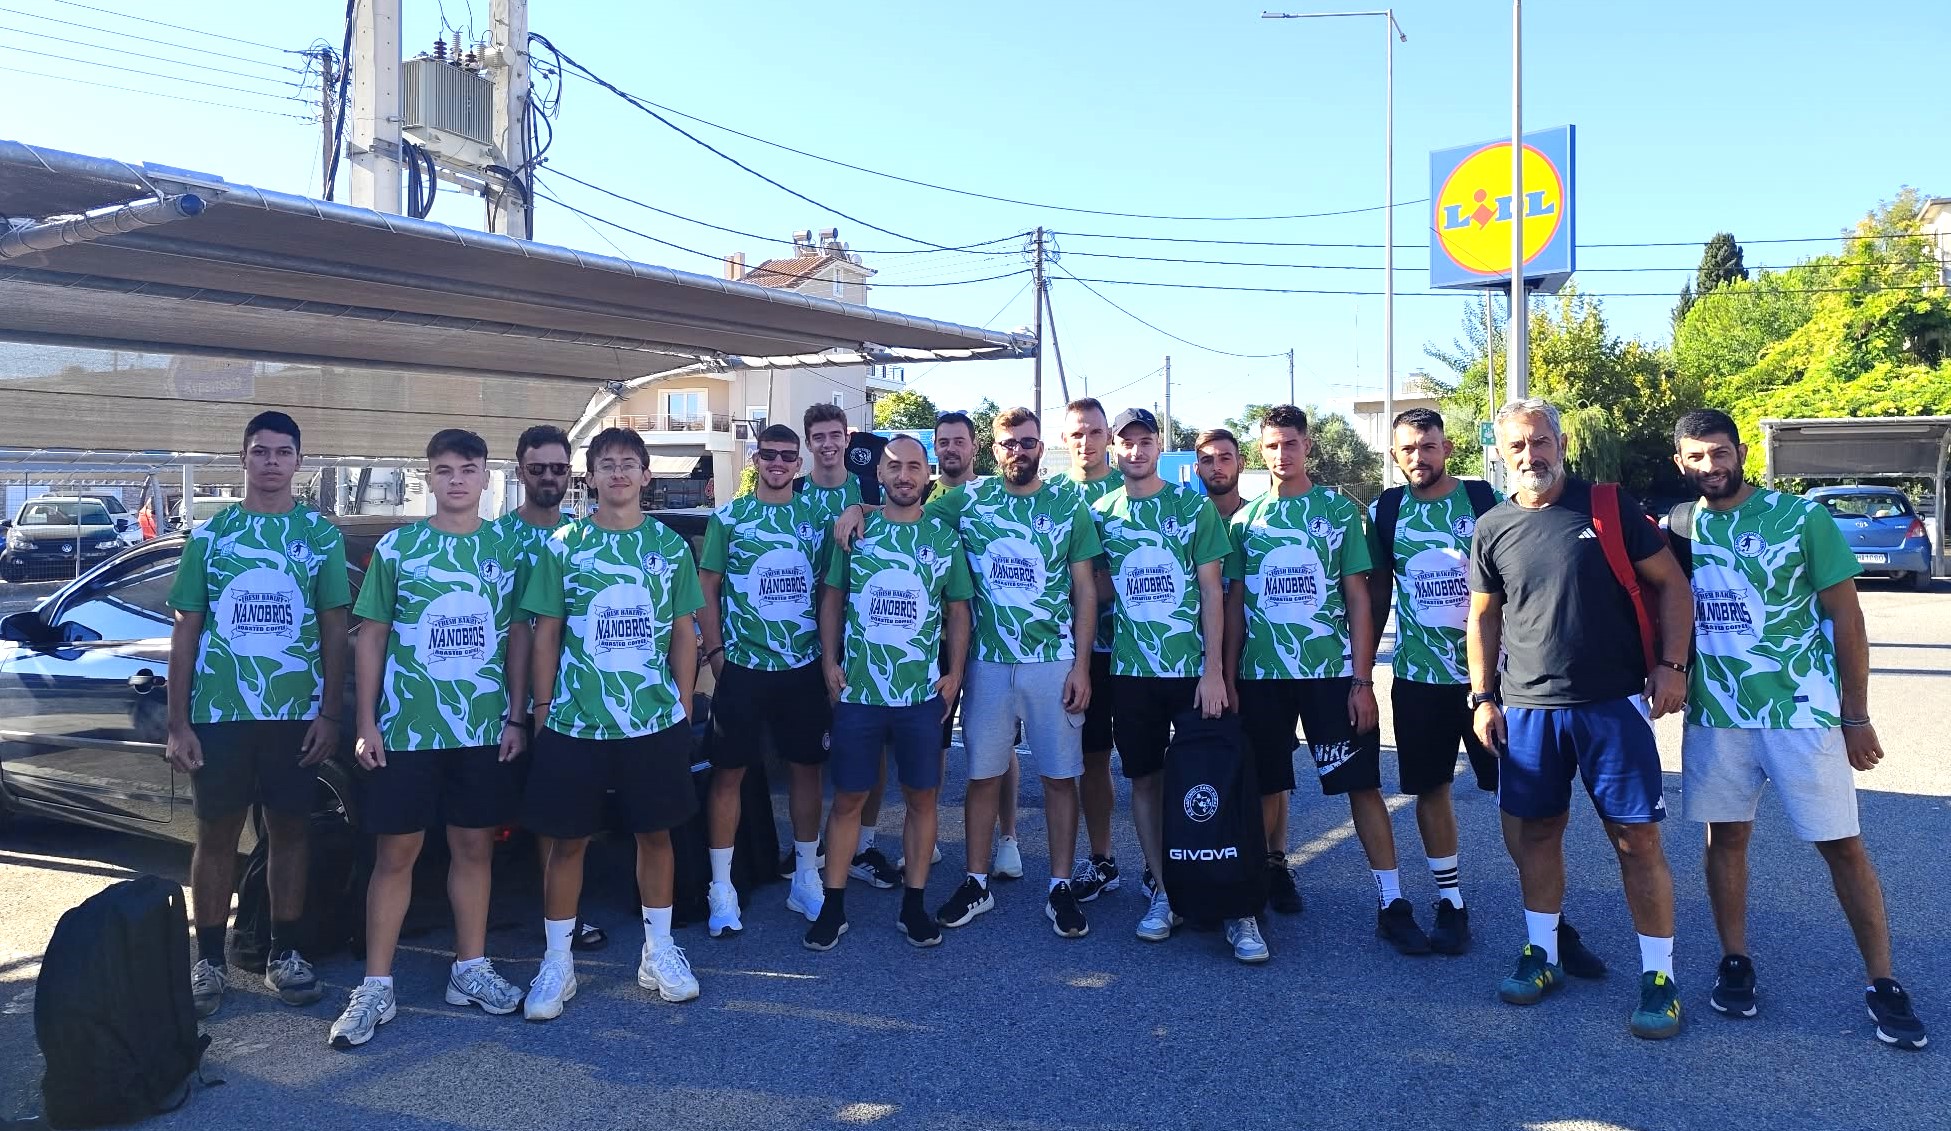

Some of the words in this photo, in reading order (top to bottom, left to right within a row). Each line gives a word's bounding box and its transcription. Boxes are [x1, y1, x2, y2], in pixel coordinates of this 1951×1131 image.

[759, 576, 807, 595] NANOBROS
[1126, 575, 1175, 596] NANOBROS
[1264, 576, 1317, 596] NANOBROS
[1415, 578, 1469, 599] NANOBROS
[232, 603, 293, 625] NANOBROS
[869, 598, 917, 620] NANOBROS
[1695, 600, 1752, 624] NANOBROS
[429, 626, 485, 649] NANOBROS
[595, 617, 652, 640] NANOBROS
[1315, 740, 1350, 761] NIKE
[1169, 847, 1237, 861] GIVOVA
